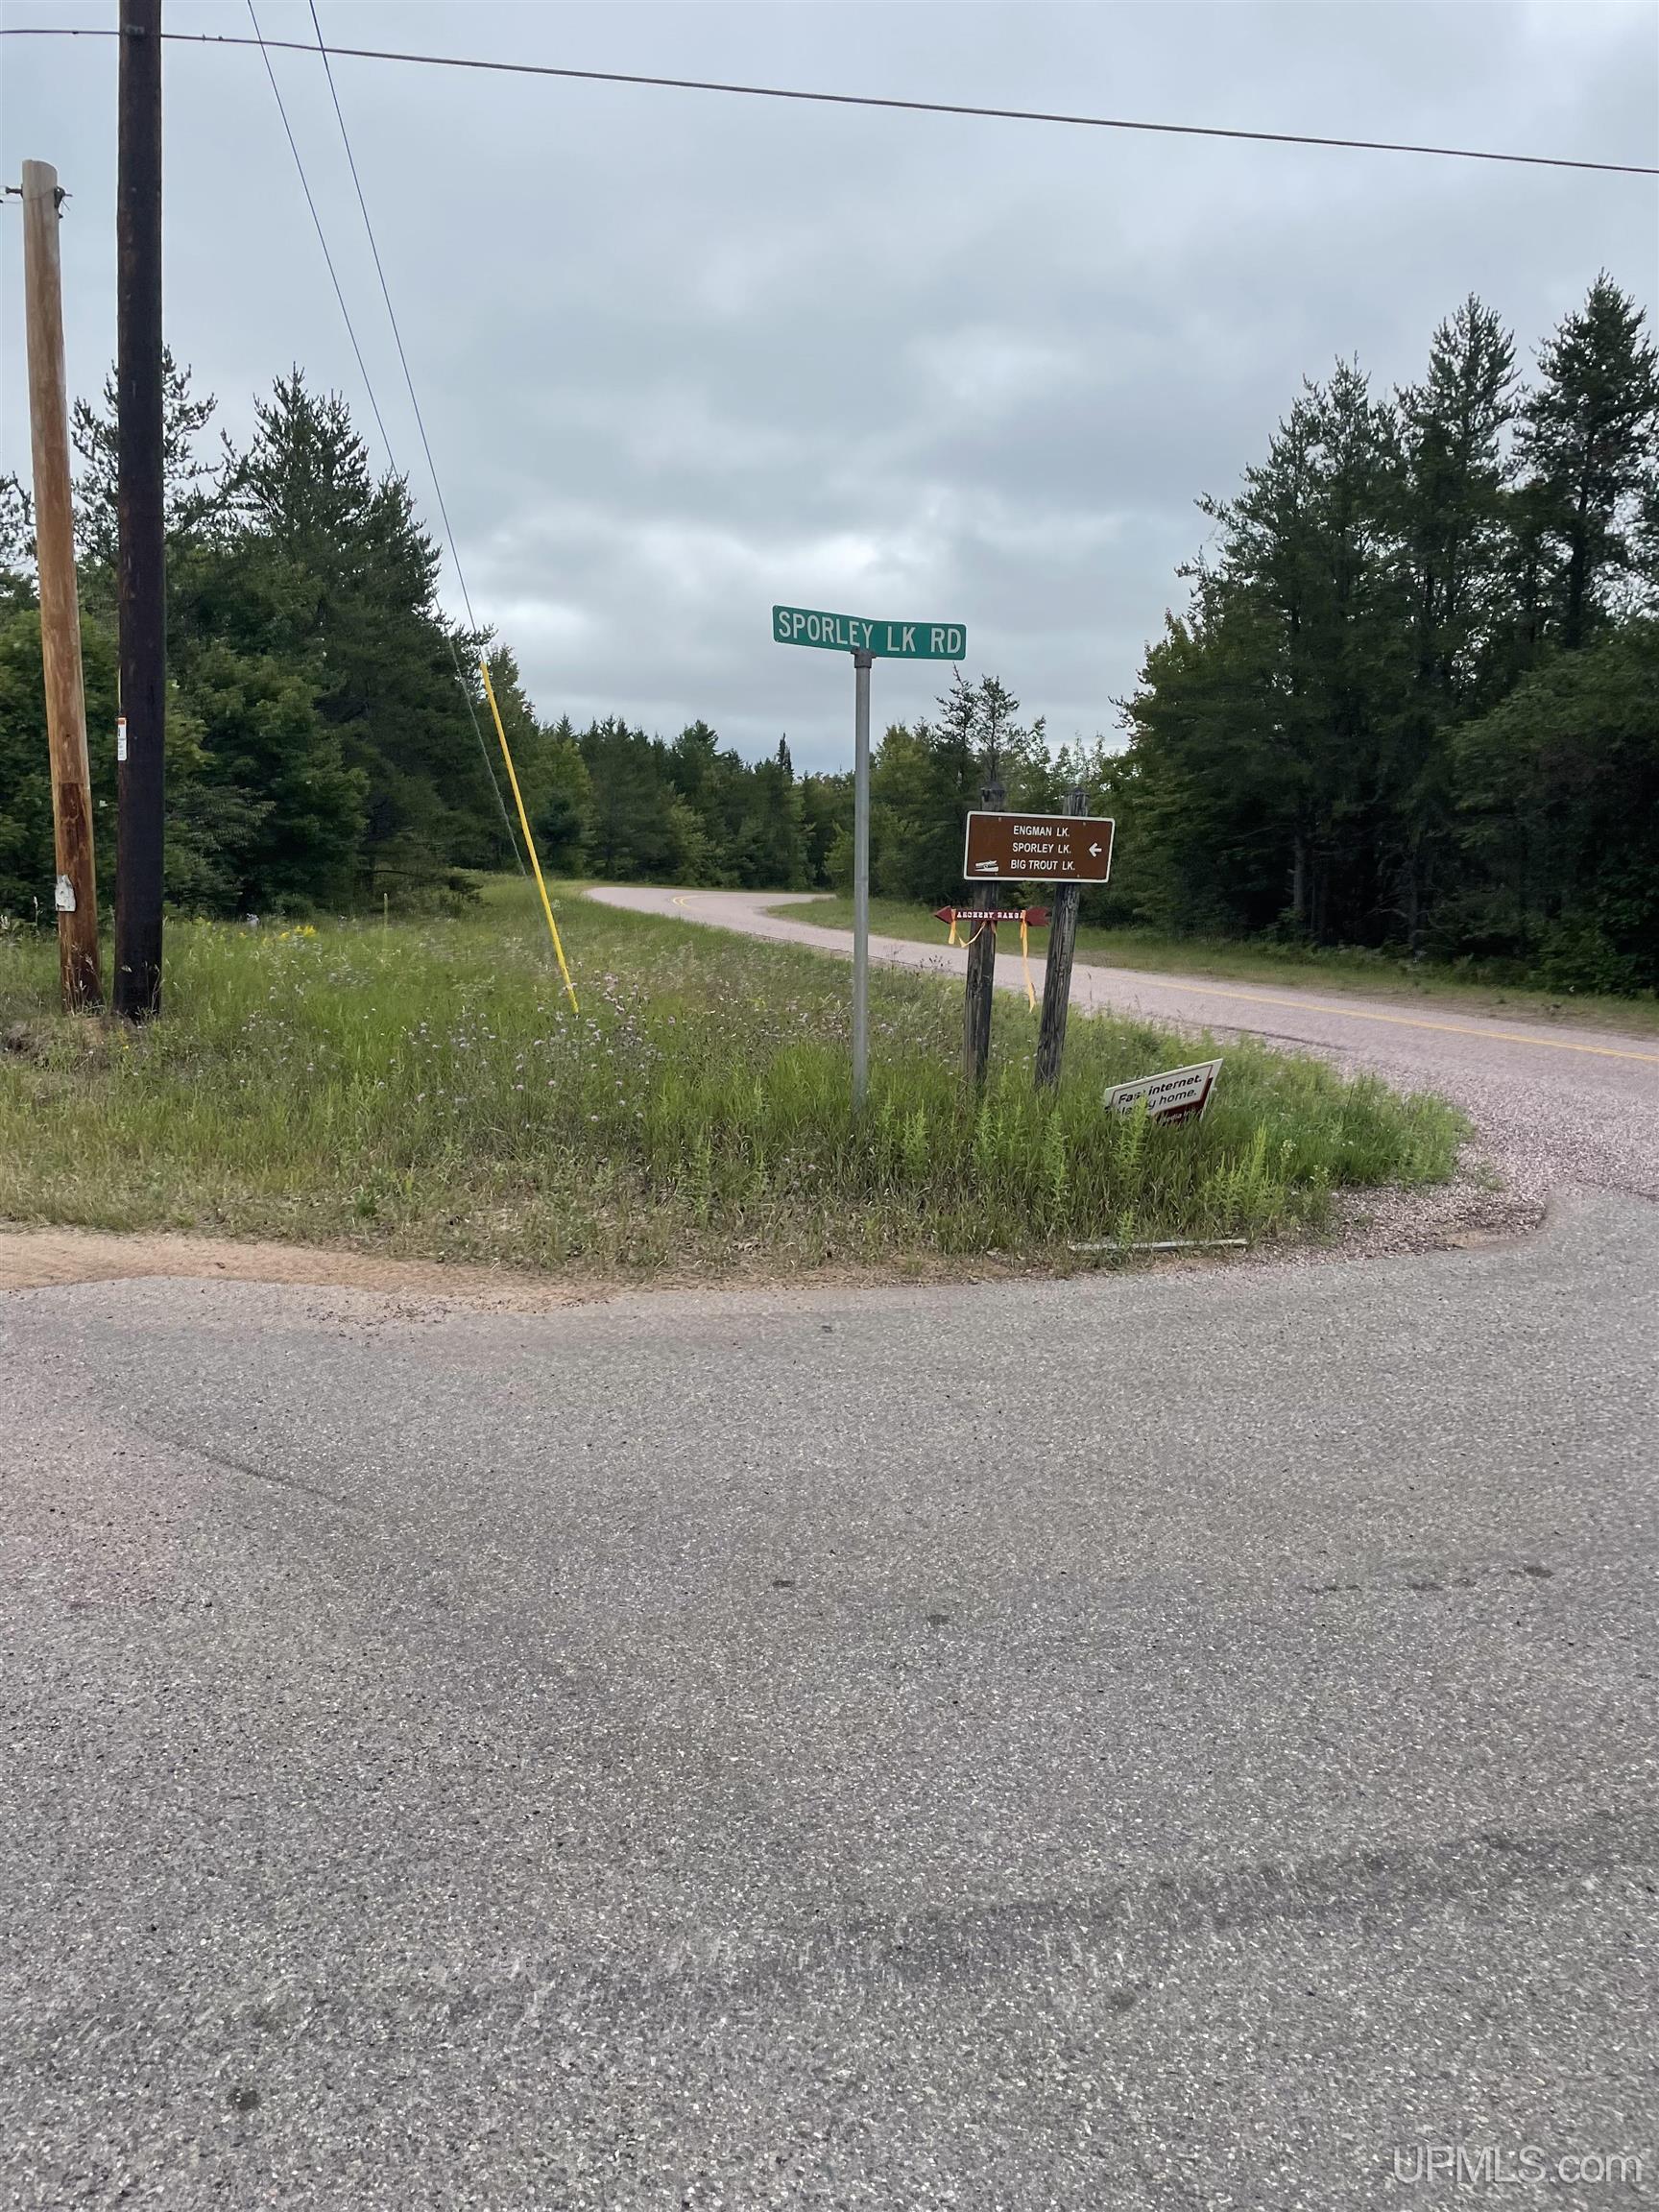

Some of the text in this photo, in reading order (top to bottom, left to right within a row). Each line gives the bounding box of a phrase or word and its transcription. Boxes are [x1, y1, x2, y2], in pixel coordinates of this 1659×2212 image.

[779, 611, 960, 654] SPORLEY LK RD
[1013, 825, 1070, 837] ENGMAN LK.
[1012, 842, 1071, 854] SPORLEY LK.
[1010, 859, 1075, 871] BIG TROUT LK.
[1118, 1074, 1202, 1104] Fas internet.
[1159, 1089, 1197, 1106] home.
